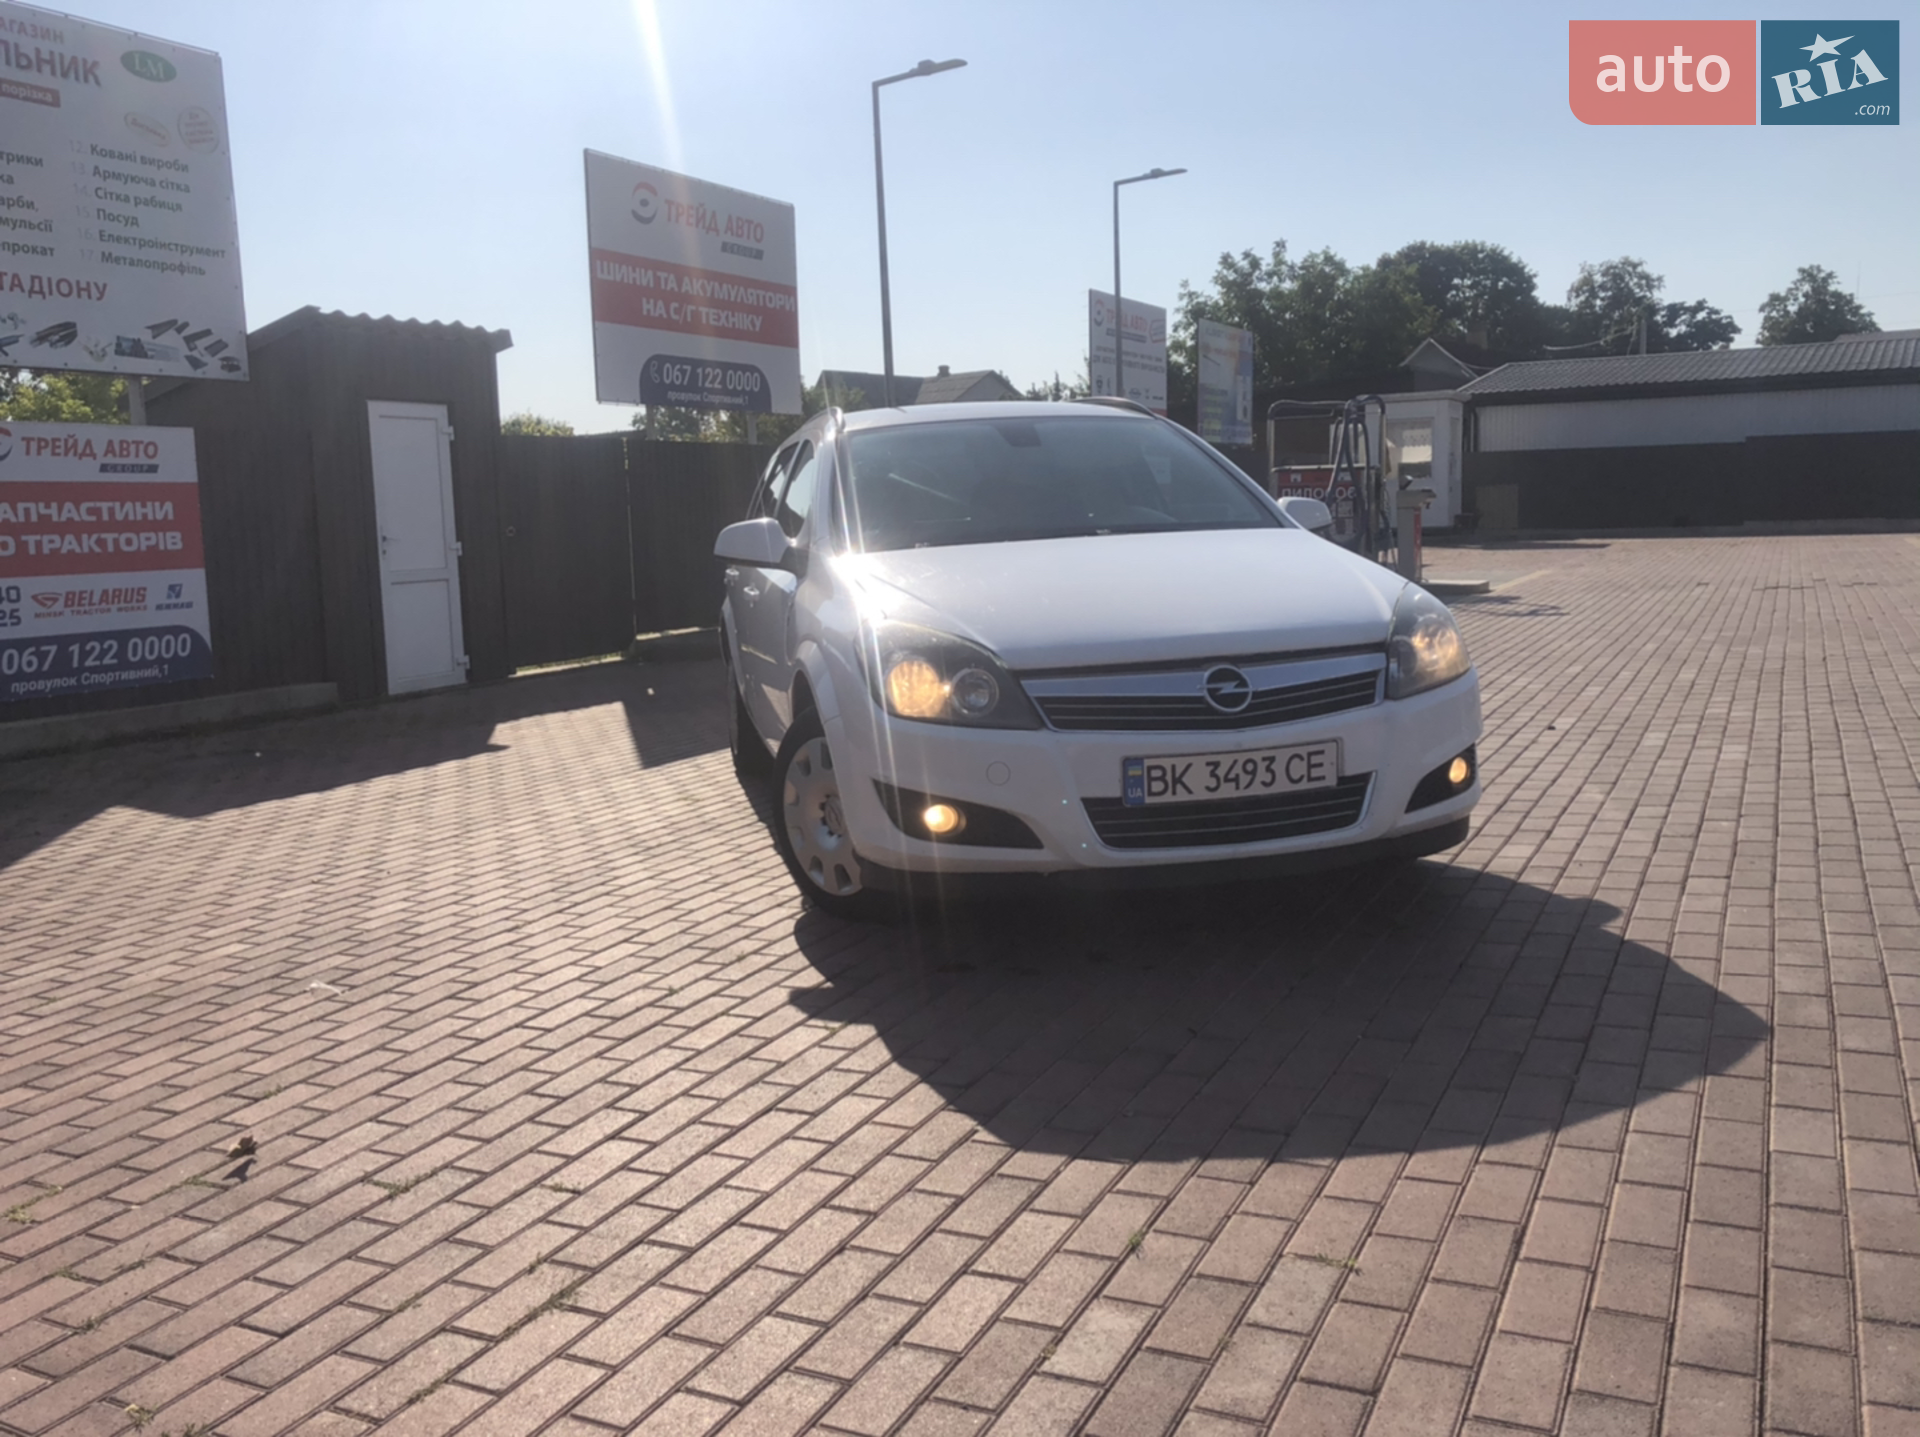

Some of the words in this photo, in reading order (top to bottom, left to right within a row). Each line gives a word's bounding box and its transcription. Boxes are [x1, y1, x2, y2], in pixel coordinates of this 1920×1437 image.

[90, 143, 137, 164] Ковані
[140, 153, 189, 174] вироби
[92, 165, 156, 188] Армуюча
[159, 176, 191, 194] сітка
[95, 186, 130, 204] Сітка
[133, 193, 182, 213] рабиця
[97, 208, 140, 228] Посуд
[664, 198, 720, 237] ТРЕЙД
[724, 213, 764, 243] АВТО
[98, 230, 226, 259] Електроінструмент
[101, 251, 206, 276] Металопрофіль
[596, 260, 654, 288] ШИНИ
[657, 271, 678, 292] ТА
[681, 276, 796, 312] АКУМУЛЯТОРИ
[642, 298, 667, 319] НА
[669, 302, 695, 324] С/Г
[698, 307, 763, 332] ТЕХНІКУ
[663, 362, 691, 386] 067
[697, 366, 723, 389] 122
[726, 370, 761, 392] 0000
[21, 433, 97, 460] ТРЕЙД
[103, 439, 158, 460] АВТО
[21, 531, 183, 555] ТРАКТОРІВ
[34, 610, 65, 619] MINSK
[70, 607, 112, 617] TRACTOR
[117, 604, 148, 614] WORKS
[63, 586, 148, 609] BELARUS
[1, 644, 57, 675] 067
[68, 639, 118, 668] 122
[127, 633, 191, 662] 0000
[11, 675, 77, 694] провулок
[1146, 762, 1194, 797] BK
[1204, 755, 1276, 793] 3493
[1285, 749, 1326, 784] CE
[1128, 788, 1143, 798] UA
